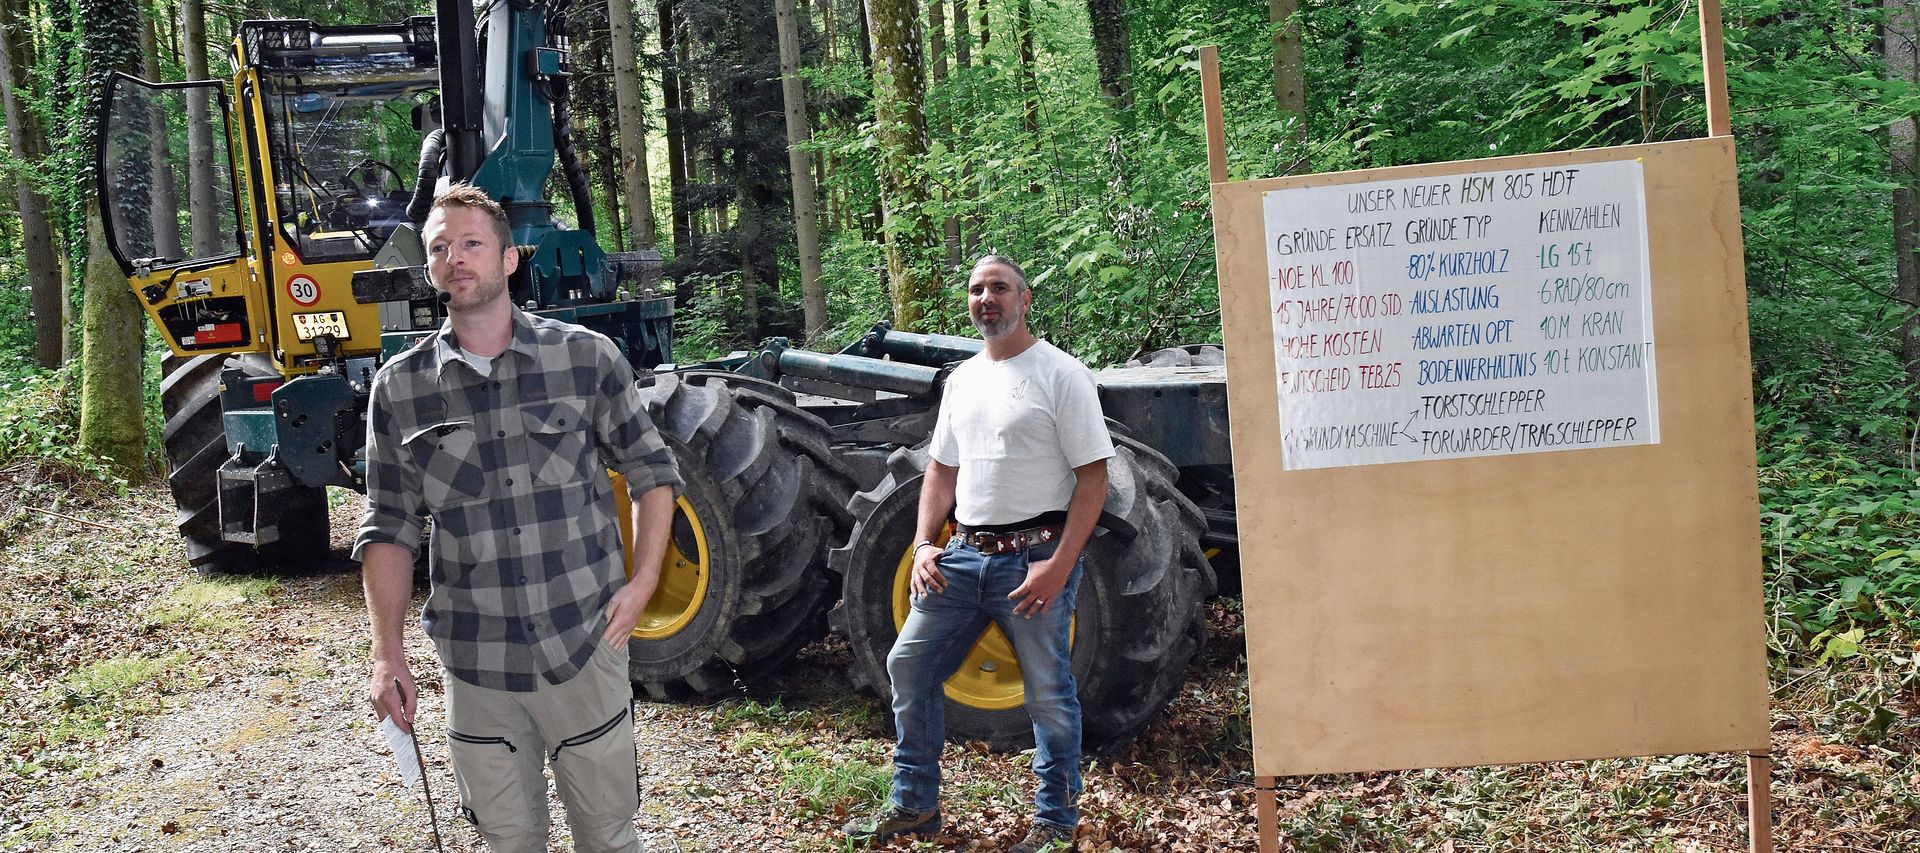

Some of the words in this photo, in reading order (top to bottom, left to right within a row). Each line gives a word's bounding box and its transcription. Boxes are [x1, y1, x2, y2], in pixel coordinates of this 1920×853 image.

[1348, 188, 1396, 214] UNSER
[1402, 183, 1450, 209] NEUER
[1460, 177, 1494, 204] HSM
[1503, 173, 1534, 201] 805
[1541, 169, 1580, 197] HDF
[1405, 217, 1458, 245] GRÜNDE
[1463, 215, 1492, 239] TYP
[1539, 203, 1621, 234] KENNZAHLEN
[1277, 227, 1337, 256] GRÜNDE
[1345, 222, 1395, 250] ERSATZ
[1311, 264, 1329, 289] KL
[1332, 260, 1354, 285] 100
[1439, 249, 1510, 278] KURZHOLZ
[293, 283, 313, 298] 30
[303, 324, 341, 339] 31229
[312, 314, 326, 324] AG
[1485, 319, 1514, 345] OPT.
[1582, 310, 1623, 337] KRAN
[1281, 334, 1320, 360] HOHE
[1323, 328, 1382, 357] KOSTEN
[1578, 341, 1653, 374] KONSTANT
[1421, 388, 1546, 420] FORSTSCHLEPPER
